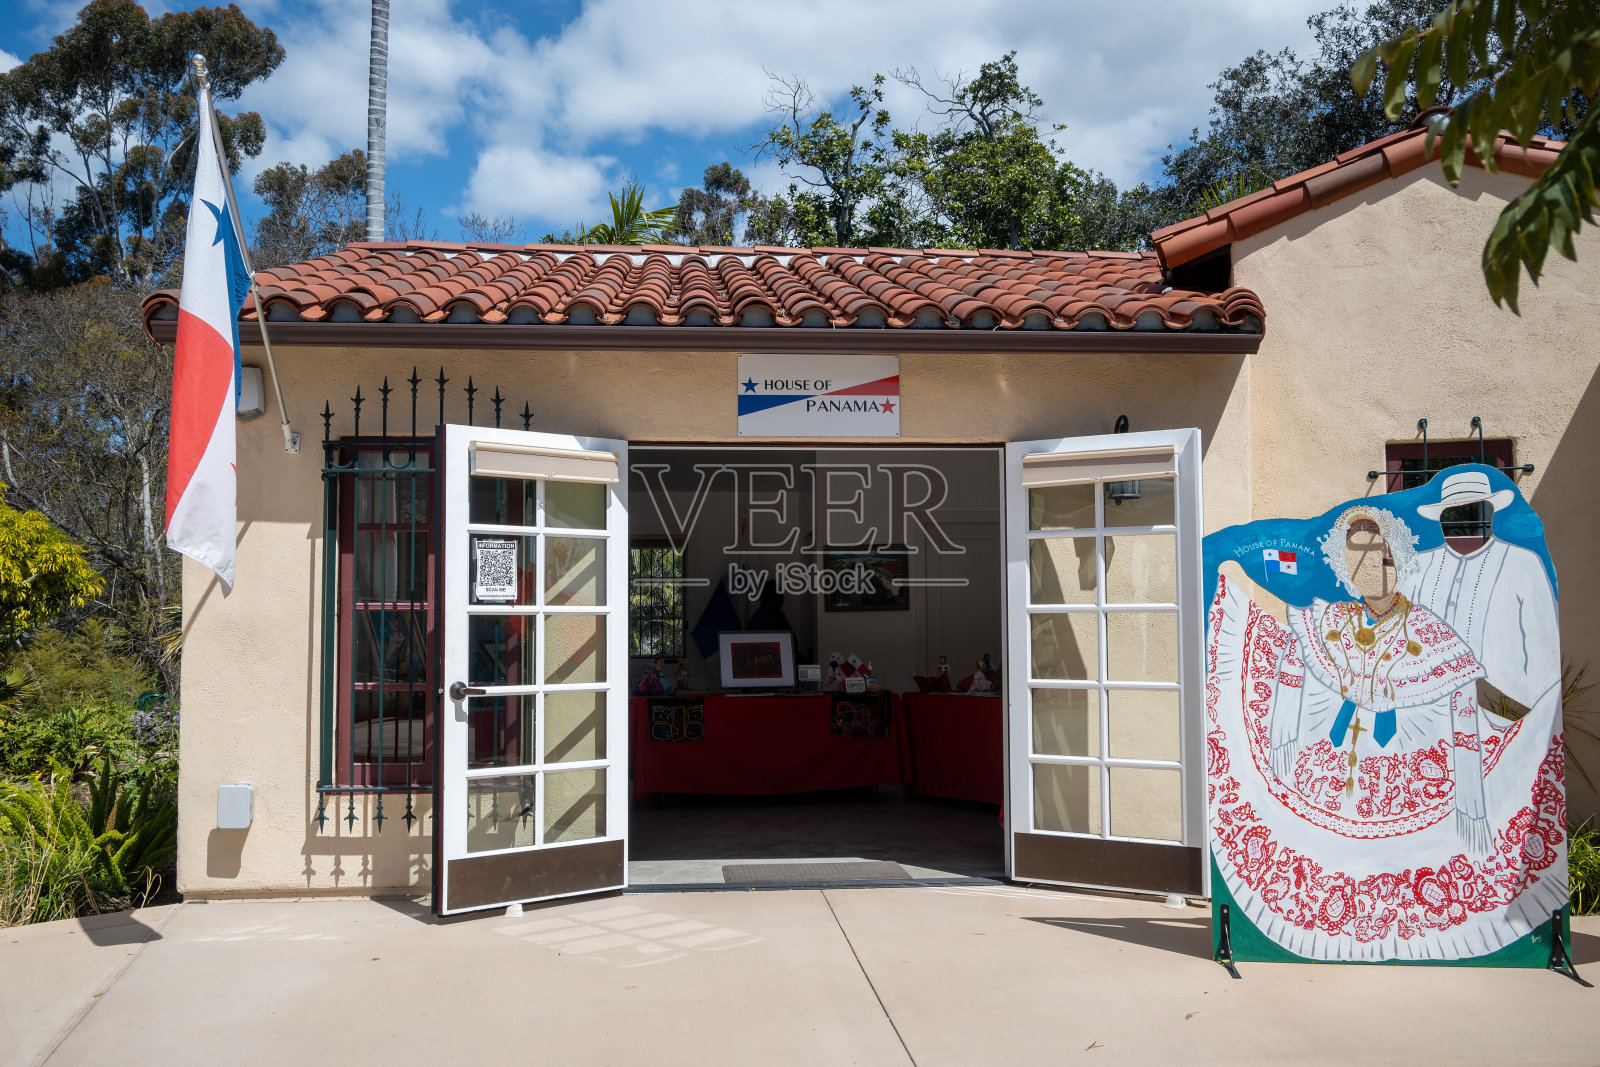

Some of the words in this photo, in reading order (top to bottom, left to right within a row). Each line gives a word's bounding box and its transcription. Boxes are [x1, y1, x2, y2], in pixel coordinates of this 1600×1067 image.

[764, 379, 810, 391] HOUSE
[813, 379, 832, 391] OF
[806, 399, 880, 412] PANAMA
